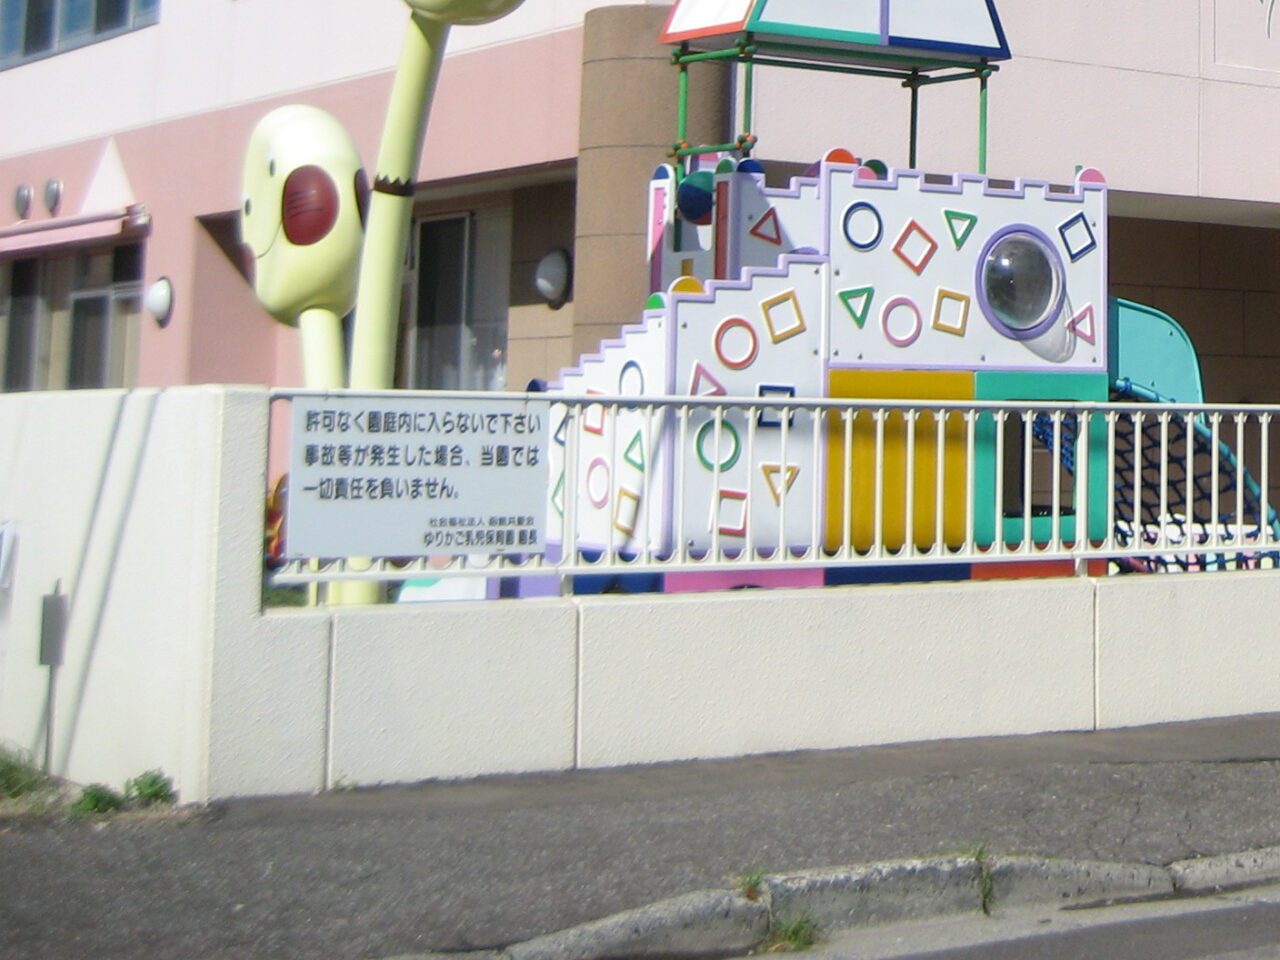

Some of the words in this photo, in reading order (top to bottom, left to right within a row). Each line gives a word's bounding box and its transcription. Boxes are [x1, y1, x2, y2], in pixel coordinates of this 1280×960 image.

[305, 410, 541, 434] 許可なく園庭内に入らないで下さい
[304, 444, 540, 467] 事故等が発生した場合、当園では
[303, 477, 460, 500] 一切責任を負いません。
